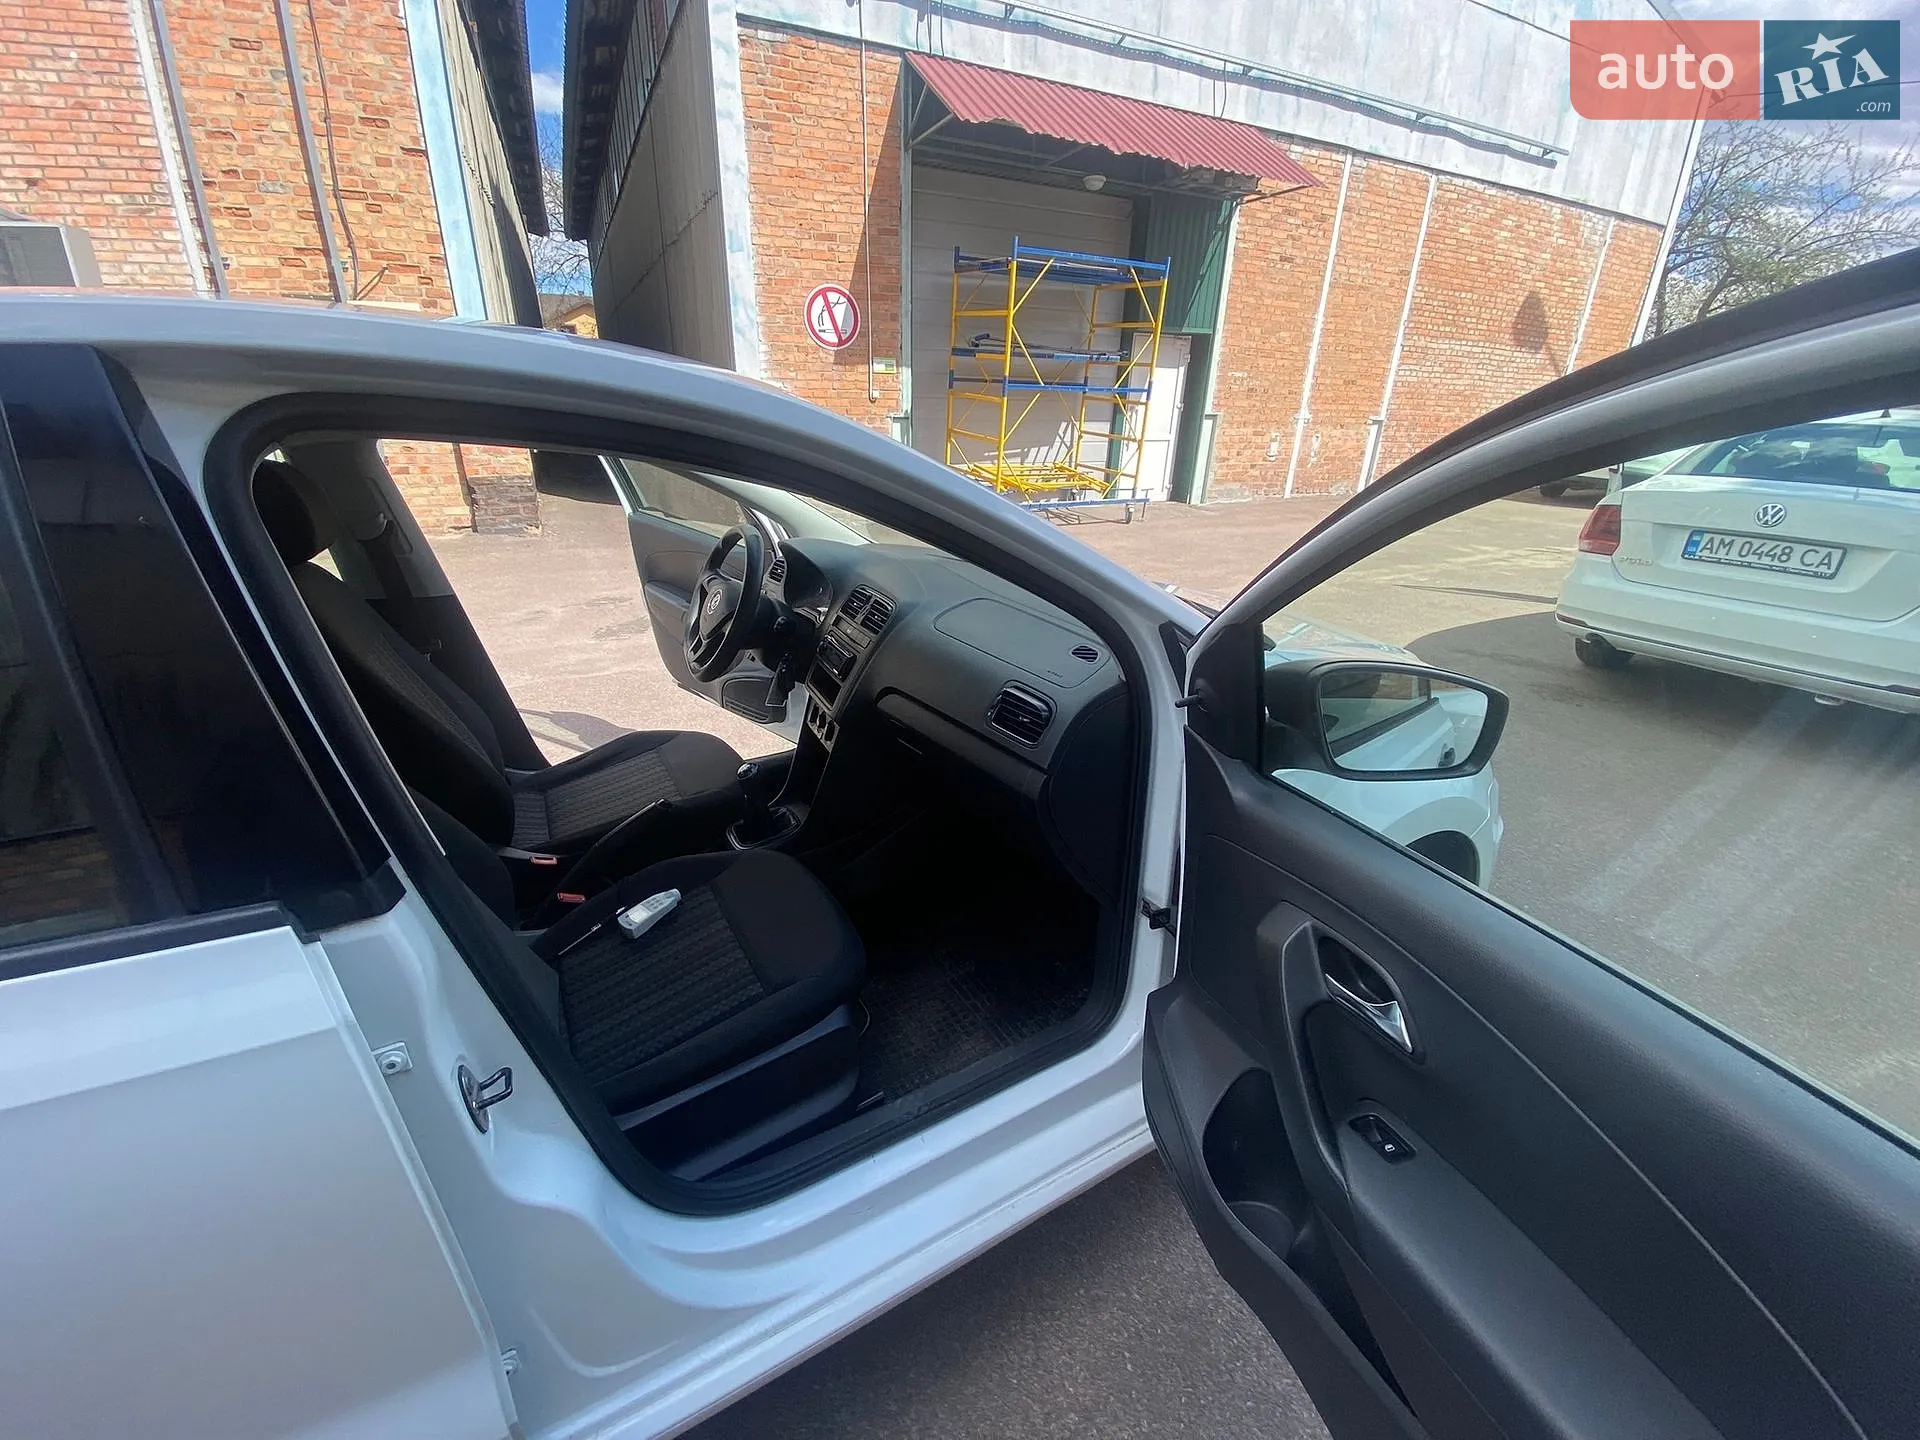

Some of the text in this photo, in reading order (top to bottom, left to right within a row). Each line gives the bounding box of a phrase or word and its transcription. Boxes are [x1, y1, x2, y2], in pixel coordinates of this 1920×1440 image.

[1699, 536, 1735, 556] AM
[1738, 540, 1794, 563] 0448
[1800, 549, 1833, 570] CA
